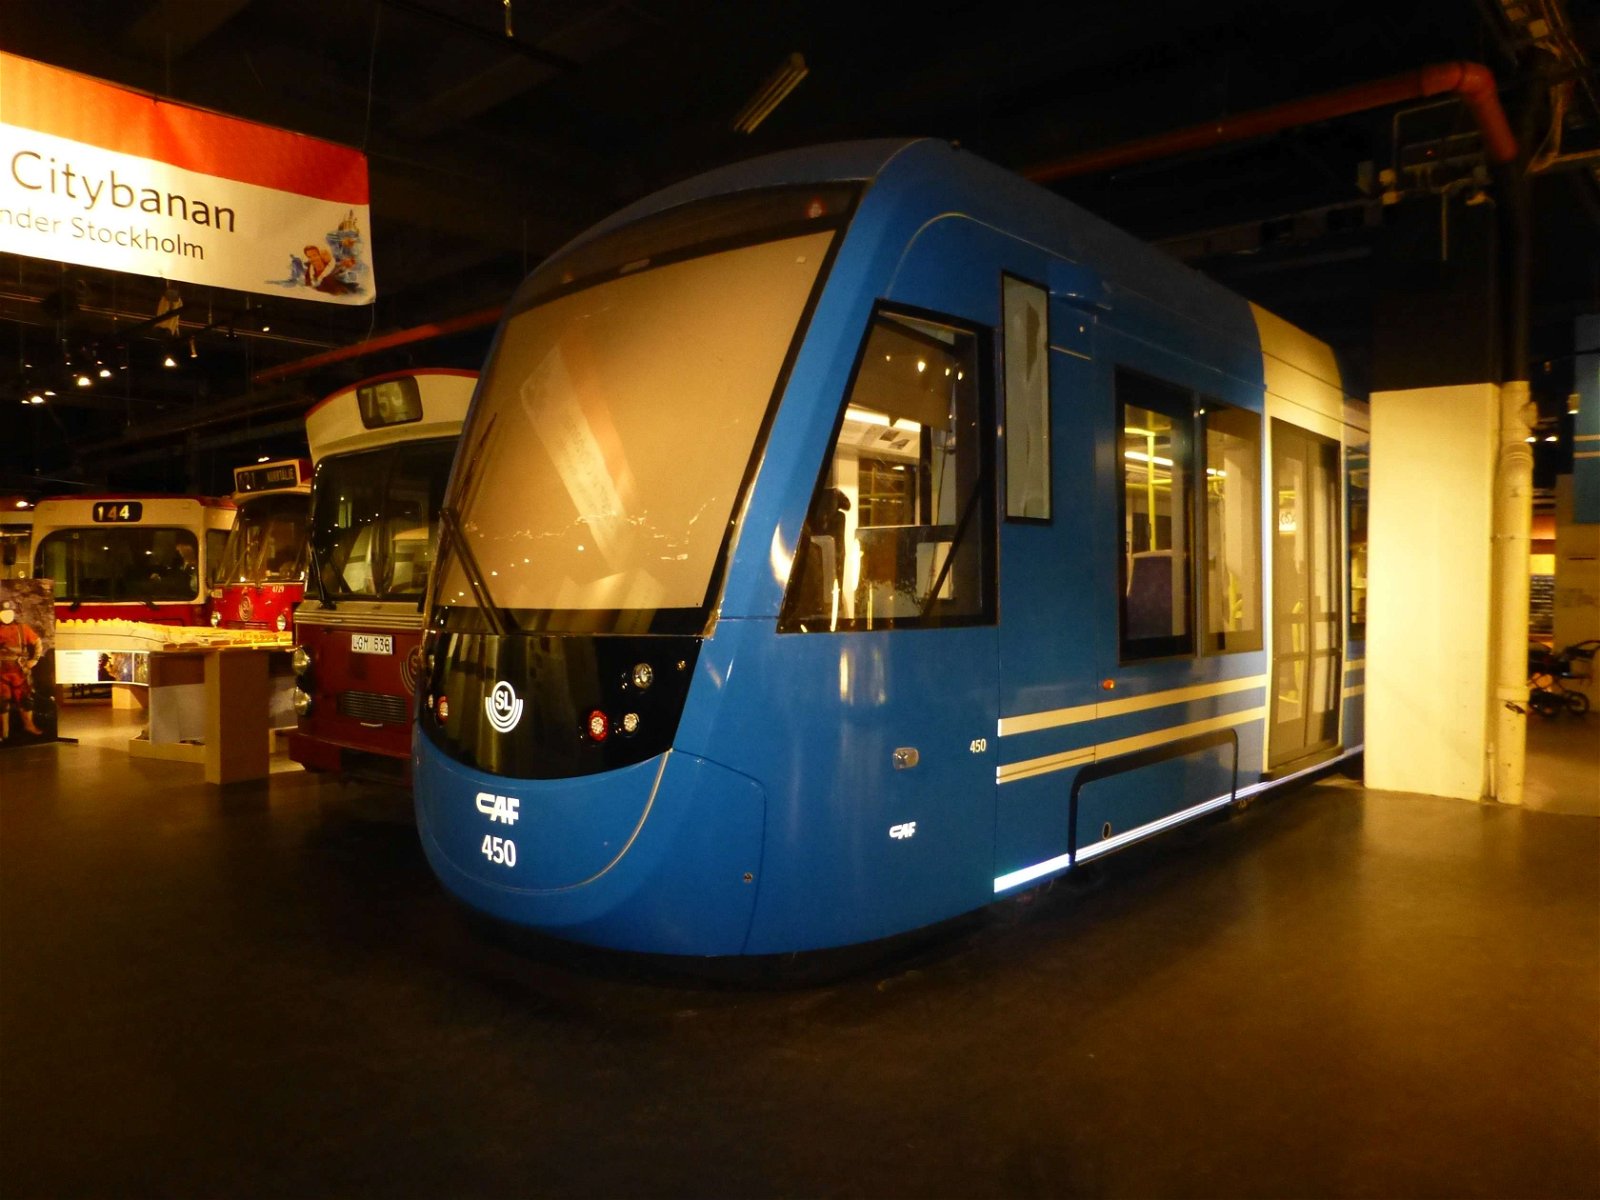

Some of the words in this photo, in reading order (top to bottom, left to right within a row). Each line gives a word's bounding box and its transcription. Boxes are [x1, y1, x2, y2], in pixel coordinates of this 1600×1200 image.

[11, 150, 235, 232] Citybanan
[71, 216, 205, 260] Stockholm
[97, 504, 130, 521] 144
[495, 690, 513, 711] SL
[969, 738, 987, 753] 450
[475, 792, 520, 826] CAF
[889, 821, 917, 840] CAF
[481, 834, 517, 867] 450
